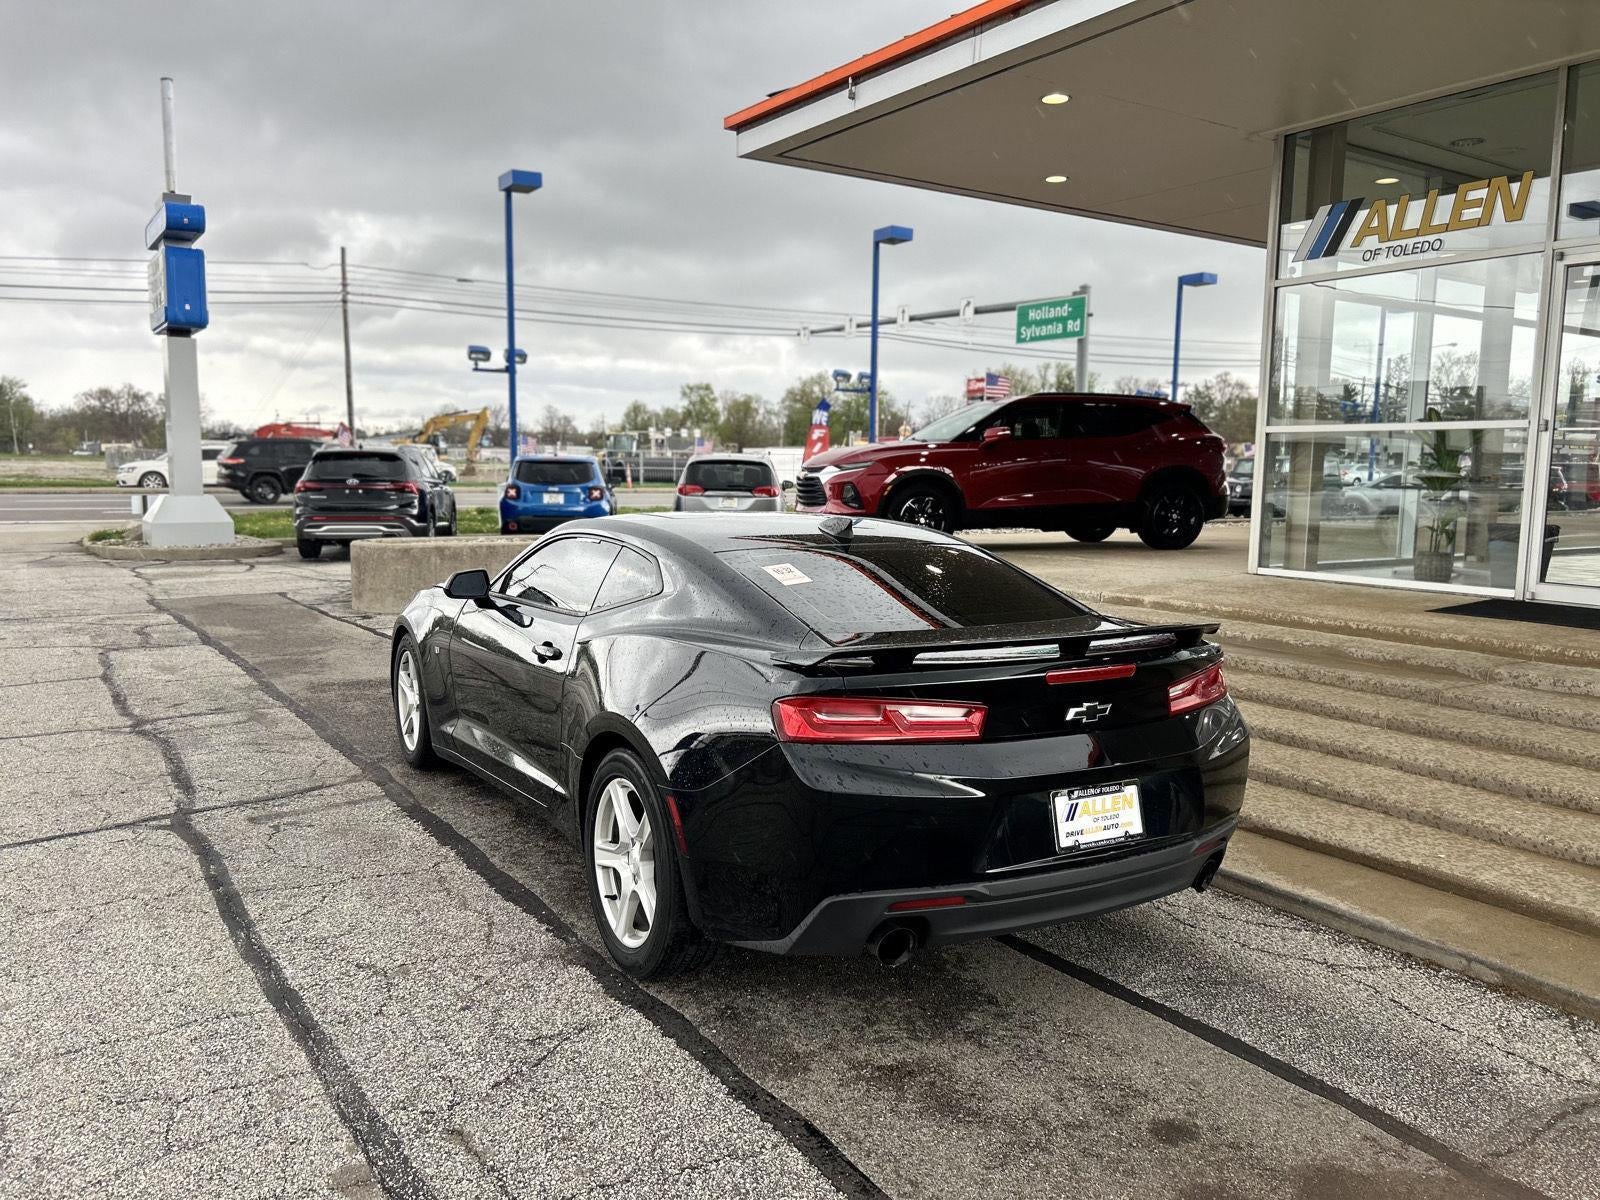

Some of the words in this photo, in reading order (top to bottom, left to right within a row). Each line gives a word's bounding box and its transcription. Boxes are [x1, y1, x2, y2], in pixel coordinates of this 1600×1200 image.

[1350, 170, 1535, 248] ALLEN
[1362, 247, 1382, 262] OF
[1385, 238, 1443, 258] TOLEDO
[1028, 303, 1072, 321] Holland-
[1020, 322, 1062, 341] Sylvania
[1067, 318, 1081, 333] Rd
[1078, 788, 1095, 796] ALLEN
[1102, 785, 1119, 793] TOLEDO
[1079, 793, 1134, 818] ALLEN
[1100, 813, 1120, 822] TOLEDO
